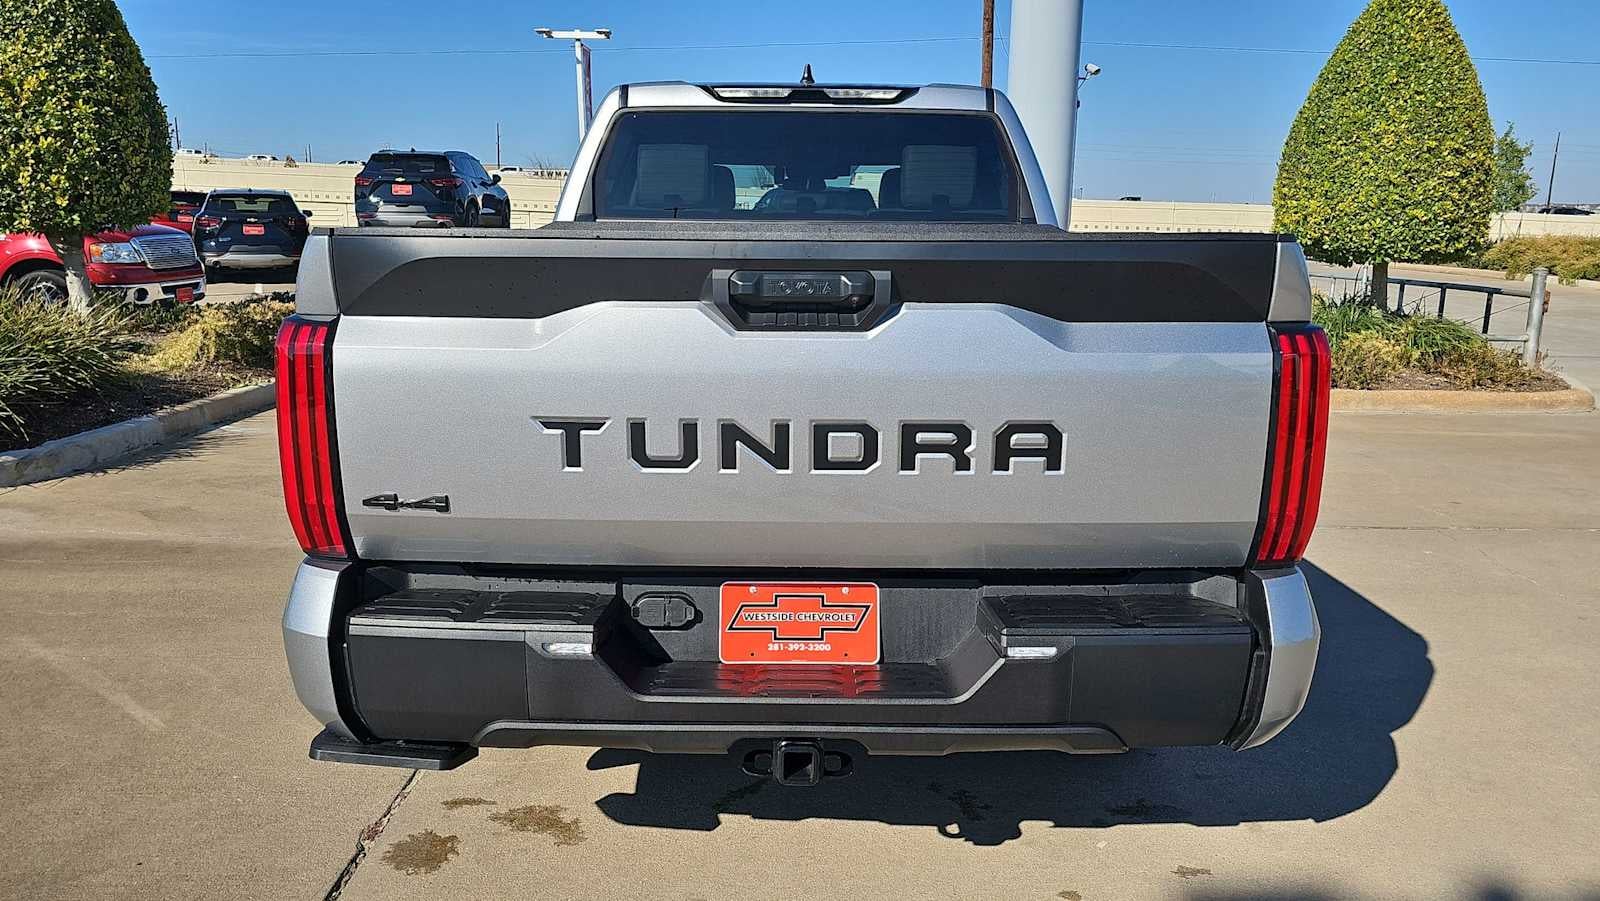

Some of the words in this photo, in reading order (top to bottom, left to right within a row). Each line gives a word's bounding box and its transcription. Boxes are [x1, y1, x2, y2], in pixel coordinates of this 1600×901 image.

[531, 417, 1067, 477] TUNDRA
[743, 612, 794, 621] WESTSIDE
[797, 612, 856, 622] CHEVROLET
[767, 643, 831, 651] 281-392-3200
